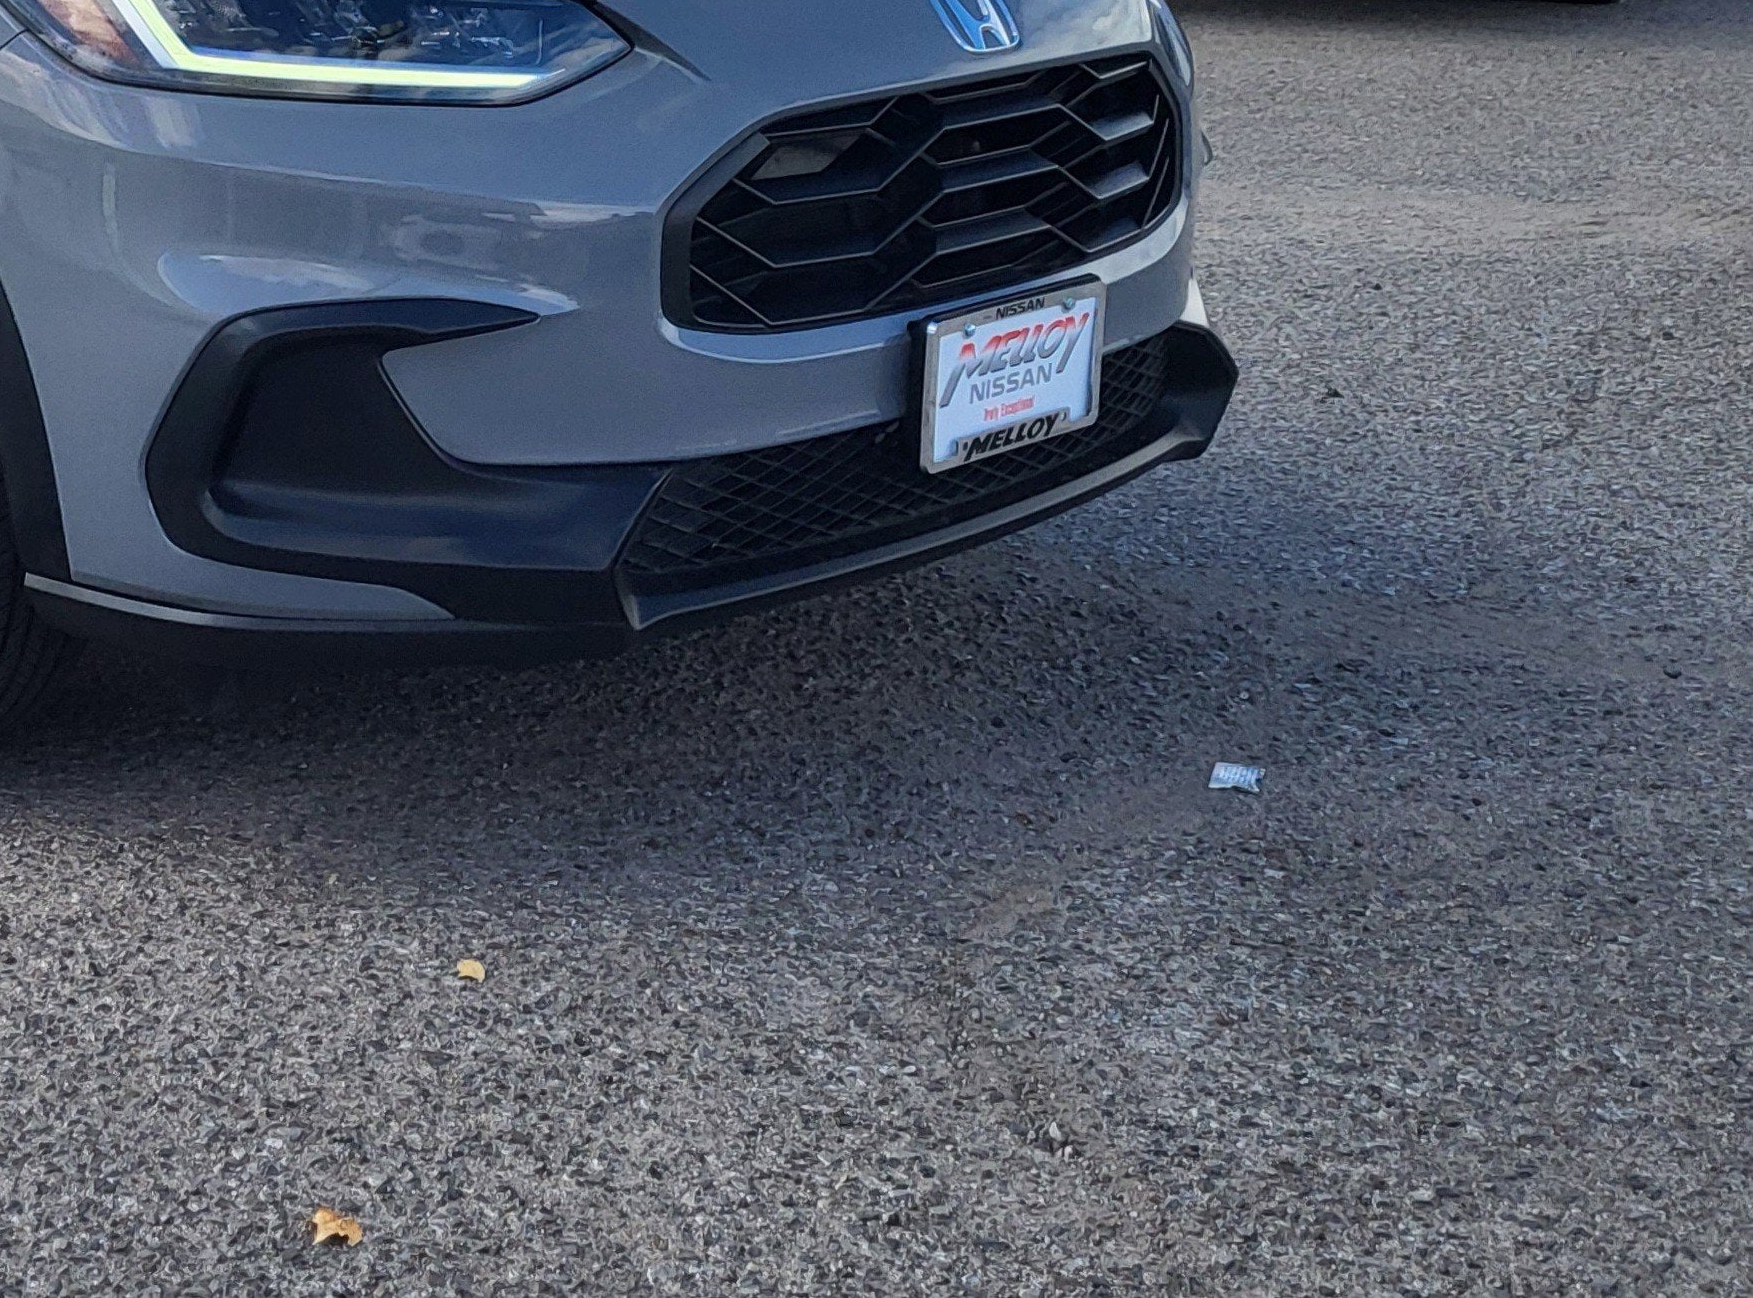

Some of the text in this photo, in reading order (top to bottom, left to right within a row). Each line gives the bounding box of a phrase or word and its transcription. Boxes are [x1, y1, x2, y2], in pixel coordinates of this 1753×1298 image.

[996, 297, 1045, 319] NISSAN
[940, 313, 1089, 407] MELLOY
[970, 363, 1053, 404] NISSAN
[964, 416, 1059, 460] MELLOY
